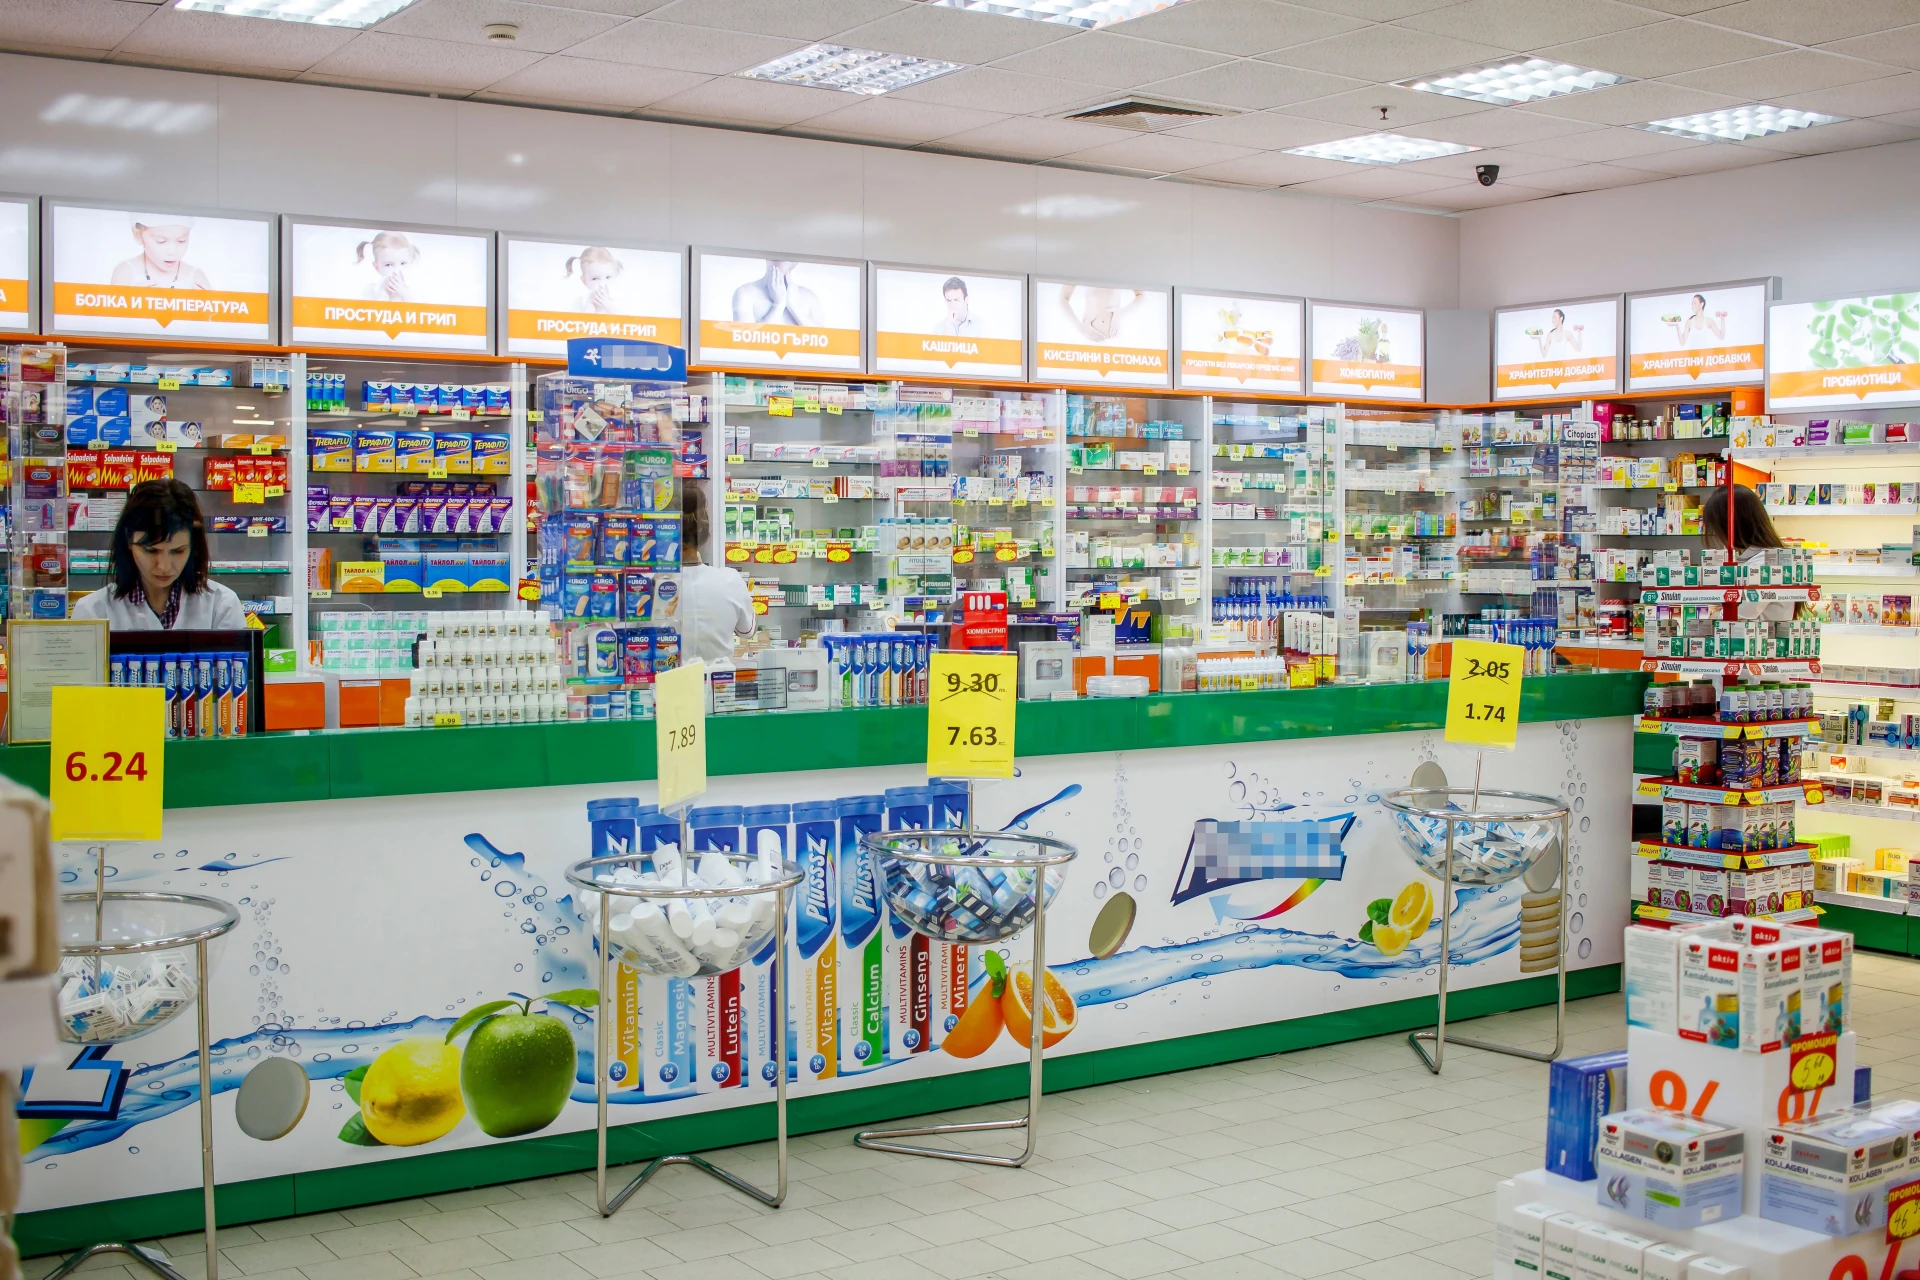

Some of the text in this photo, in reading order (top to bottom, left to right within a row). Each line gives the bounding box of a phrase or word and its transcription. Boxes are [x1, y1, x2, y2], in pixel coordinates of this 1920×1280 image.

[75, 292, 249, 315] БОЛКА И ТЕМПЕРАТУРА
[325, 307, 457, 326] ПРОСТУДА И ГРИП
[537, 319, 657, 337] ПРОСТУДА И ГРИП
[733, 329, 829, 347] БОЛНО ГЪРЛО
[922, 340, 978, 355] КАШЛИЦА
[1044, 350, 1162, 367] КИСЕЛИНИ В СТОМАХА
[1186, 359, 1216, 368] ПРОДУКТИ
[1226, 362, 1255, 370] ЛЕКАРСКО
[1256, 364, 1295, 373] ПРЕДПИСАНИЕ
[1643, 352, 1751, 371] ХРАНИТЕЛНИ ДОБАВКИ
[1339, 367, 1395, 381] ХОМЕОПАТИЯ
[1509, 363, 1604, 381] ХРАНИТЕЛНИ ДОБАВКИ
[1823, 371, 1901, 388] ПРОБИОТИЦИ
[315, 437, 350, 446] THERAFLU
[358, 437, 393, 447] ТЕРАФЛУ
[397, 438, 432, 448] ТЕРАФЛУ
[1567, 429, 1597, 440] Citoplast
[436, 439, 470, 449] ТЕРАФЛУ
[474, 439, 508, 449] ТЕРАФЛУ
[67, 453, 98, 462] Solpadeine
[104, 454, 135, 463] Solpadeine
[140, 455, 171, 464] Solpadeine
[645, 456, 667, 464] URGO
[41, 600, 58, 608] durex
[1660, 591, 1681, 601] Sinulan
[1760, 591, 1777, 600] Sinulan
[1468, 659, 1510, 679] 2.05
[1660, 662, 1681, 671] Sinulan
[947, 673, 998, 693] 9.30
[1465, 703, 1506, 722] 1.74
[669, 724, 696, 752] 7.89
[947, 726, 997, 746] 7.63
[65, 751, 148, 781] 6.24
[659, 859, 673, 871] Dove
[1693, 902, 1707, 911] -50%
[1754, 932, 1777, 941] aktiv
[1711, 954, 1735, 964] aktiv
[1824, 946, 1840, 956] aktiv
[953, 945, 965, 1008] Minera
[1683, 969, 1735, 986] Хепабаланс
[1803, 968, 1840, 981] Хепабаланс
[899, 945, 907, 1024] MULTIVITAMINS
[914, 951, 928, 1022] Ginseng
[820, 957, 832, 1046] Vitamin C
[867, 963, 879, 1034] Calcium
[623, 980, 635, 1055] Vitamin
[673, 979, 686, 1055] Magnesiu
[706, 975, 716, 1057] MULTIVITAMINS
[758, 973, 766, 1056] MULTIVITAMINS
[850, 1001, 859, 1037] Classic
[724, 996, 738, 1055] Lutein
[655, 1020, 664, 1058] Classic
[1790, 1034, 1837, 1054] ПРОМОЦИЯ
[1600, 1147, 1675, 1175] KOLLAGEN PLUS
[1682, 1162, 1717, 1176] KOLLAGEN
[1764, 1158, 1844, 1184] KOLLAGEN PLUS
[1849, 1167, 1883, 1183] KOLLAGEN
[1889, 1184, 1920, 1202] ПРОМОЦ
